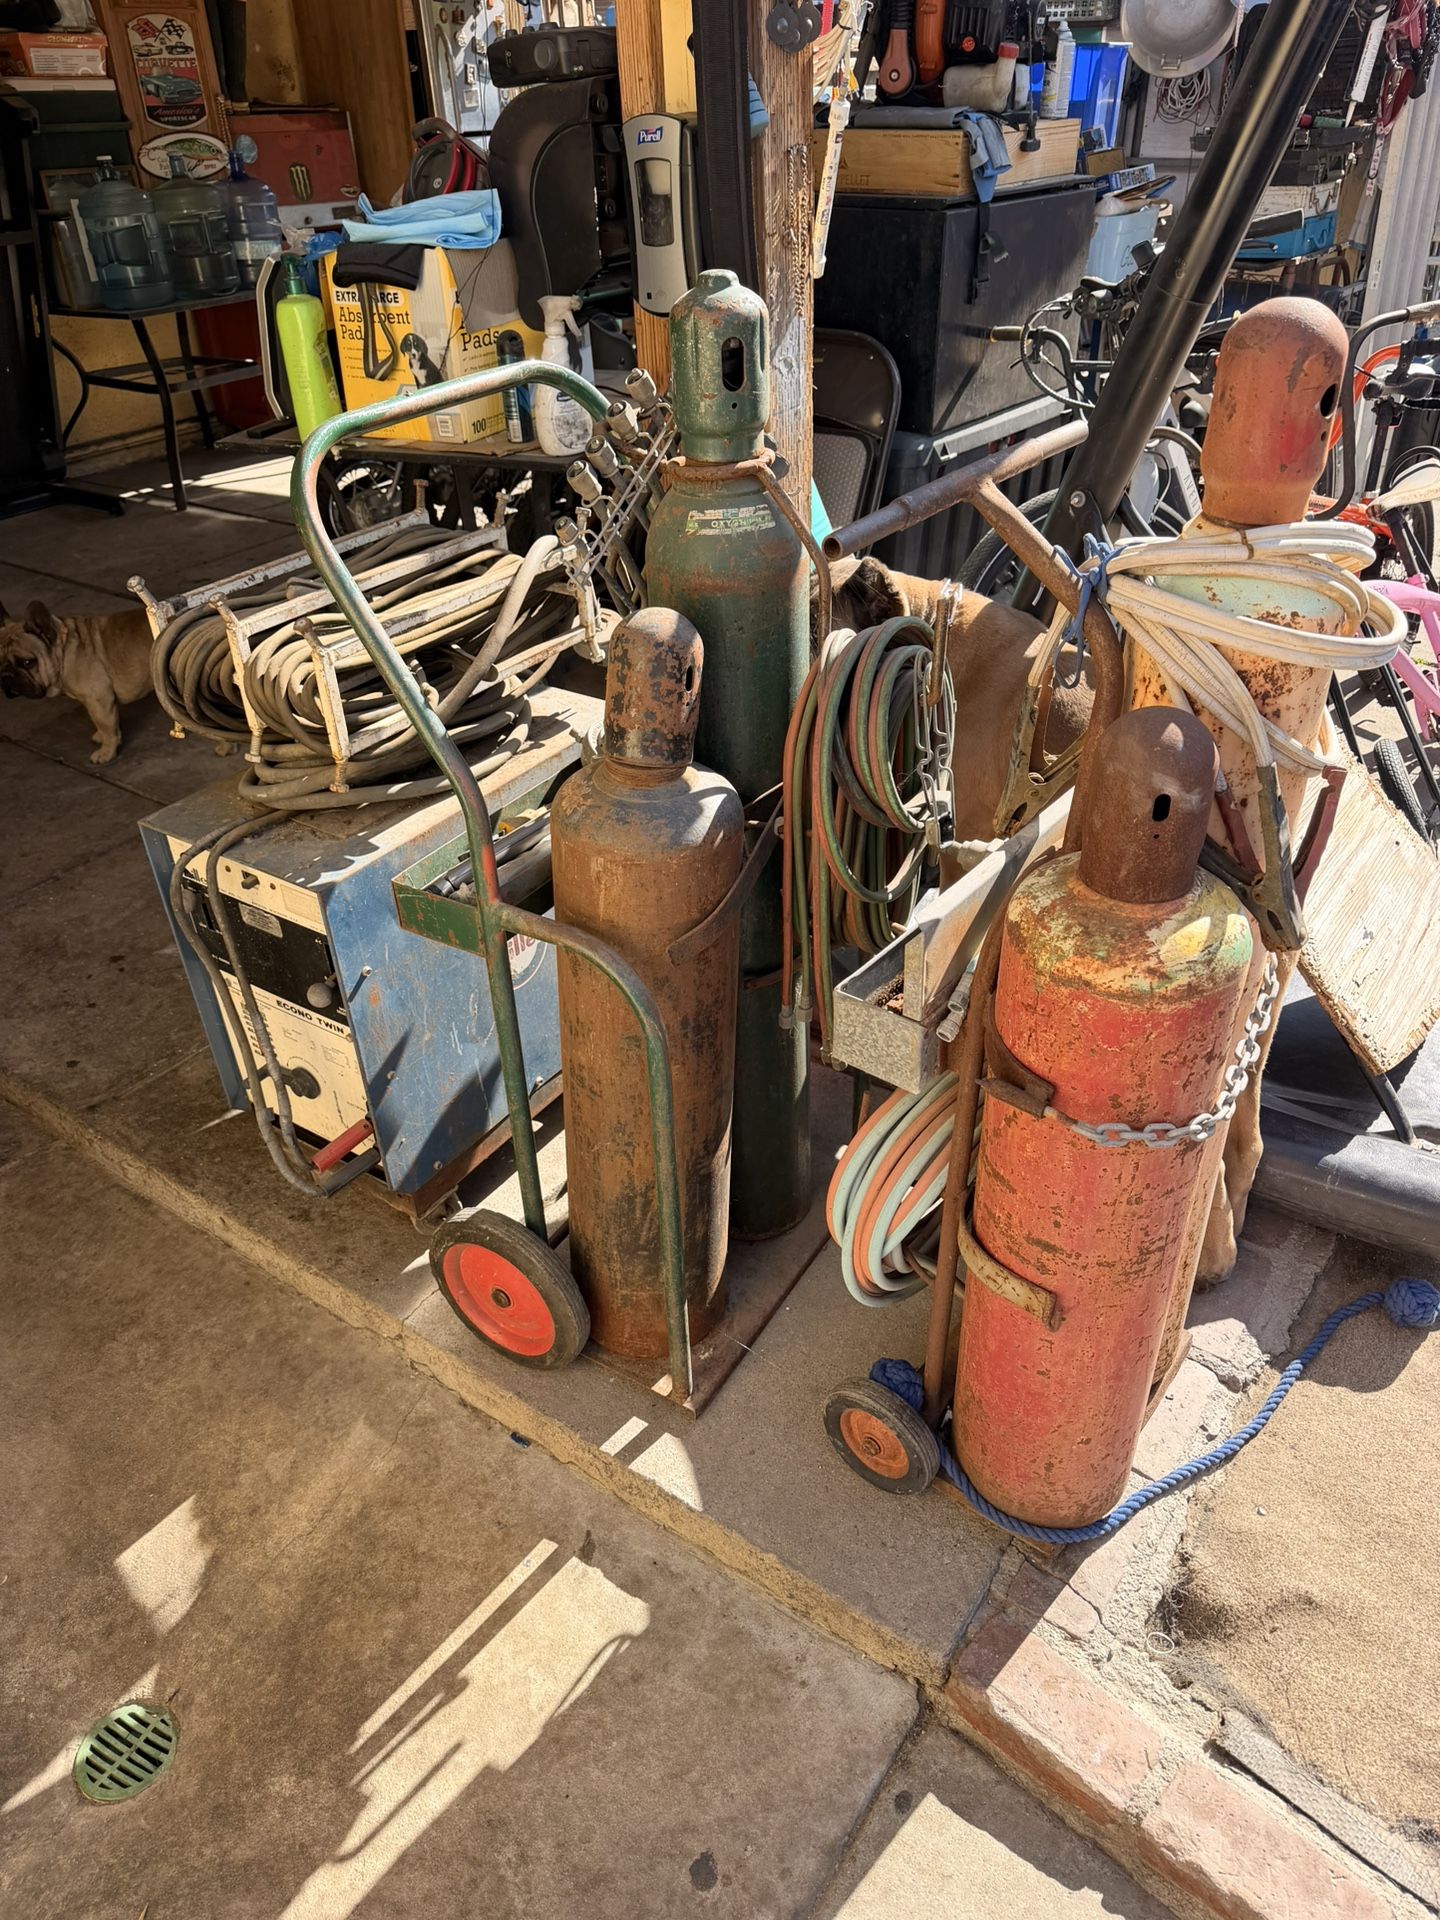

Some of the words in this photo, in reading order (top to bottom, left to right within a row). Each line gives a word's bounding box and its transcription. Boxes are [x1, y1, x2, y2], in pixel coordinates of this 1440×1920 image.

[335, 290, 360, 303] EXTR
[339, 306, 411, 325] Absrbent
[340, 324, 364, 341] Pad
[460, 328, 500, 352] Pads
[471, 417, 487, 434] 100
[275, 999, 313, 1020] ECONO
[316, 1017, 345, 1035] TWIN
